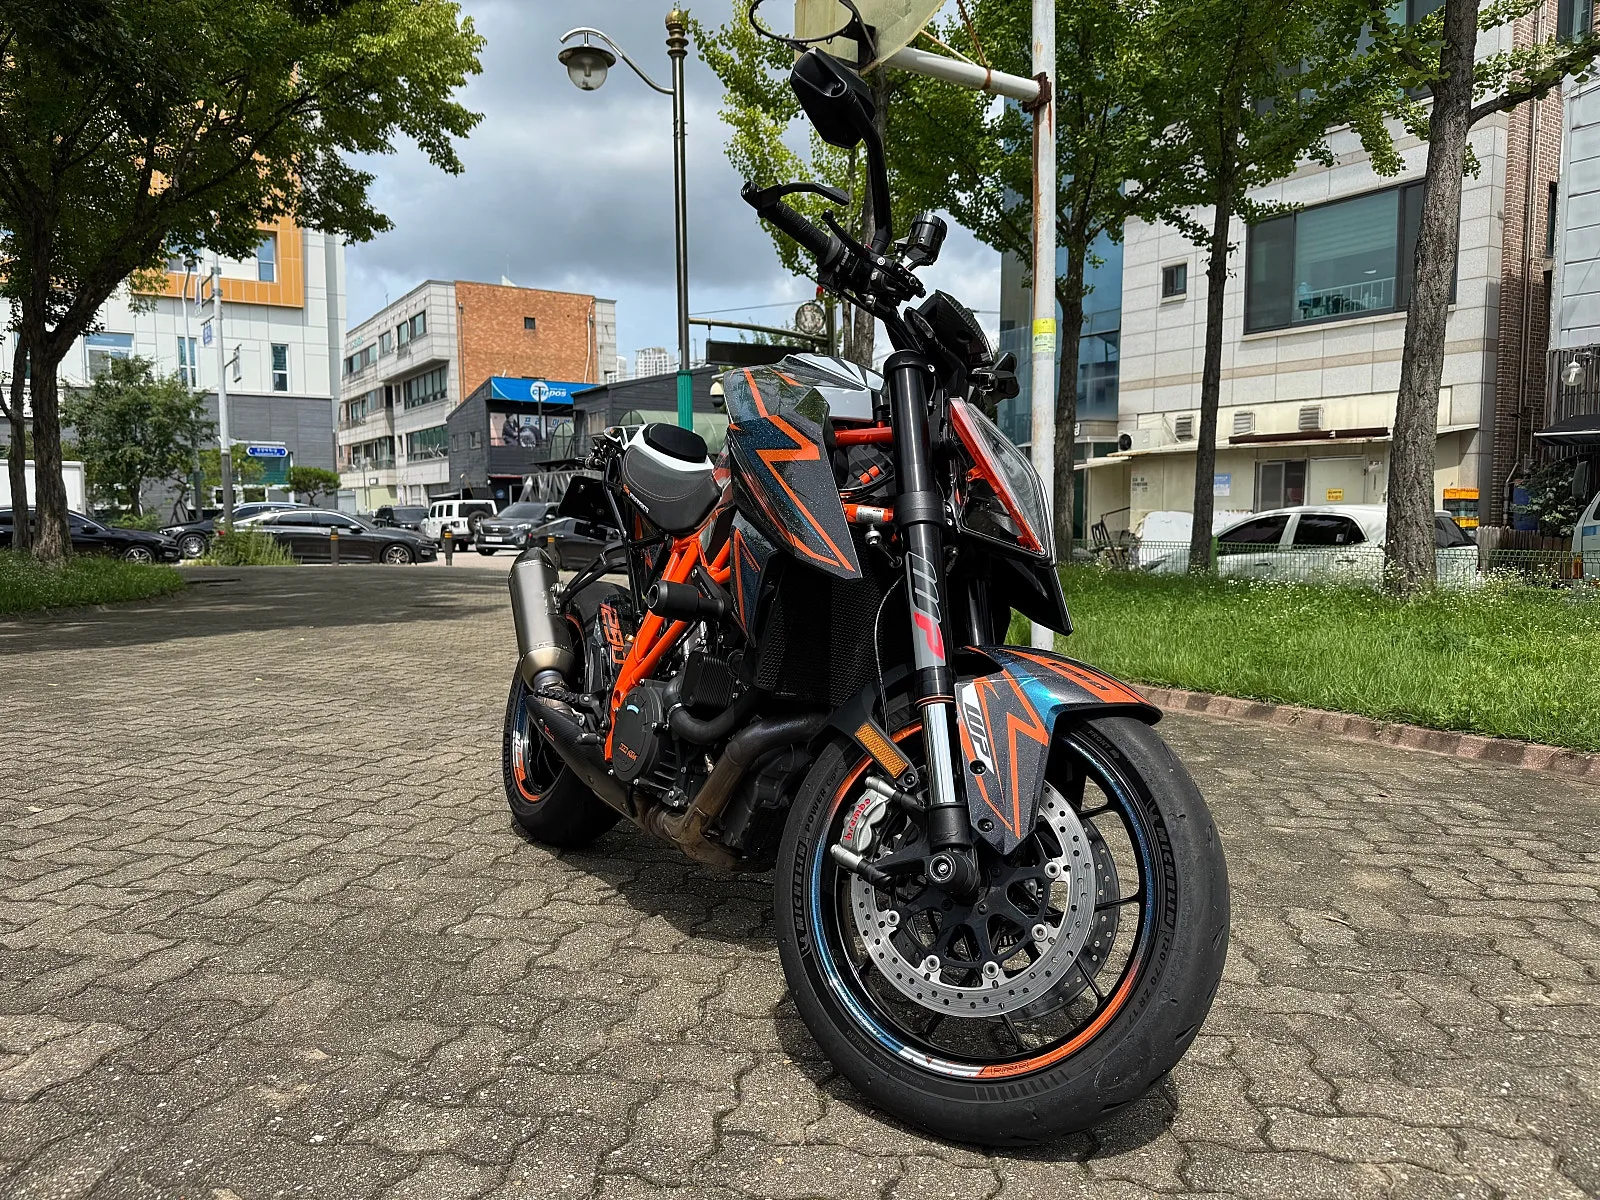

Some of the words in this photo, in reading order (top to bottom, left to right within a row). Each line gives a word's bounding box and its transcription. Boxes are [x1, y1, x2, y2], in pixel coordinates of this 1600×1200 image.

[1087, 730, 1111, 749] FRONT
[844, 798, 871, 841] brembo
[792, 842, 807, 931] MICHELIN
[805, 788, 827, 833] POWER
[1156, 827, 1175, 928] MICHELIN
[1151, 937, 1170, 986] 120/70
